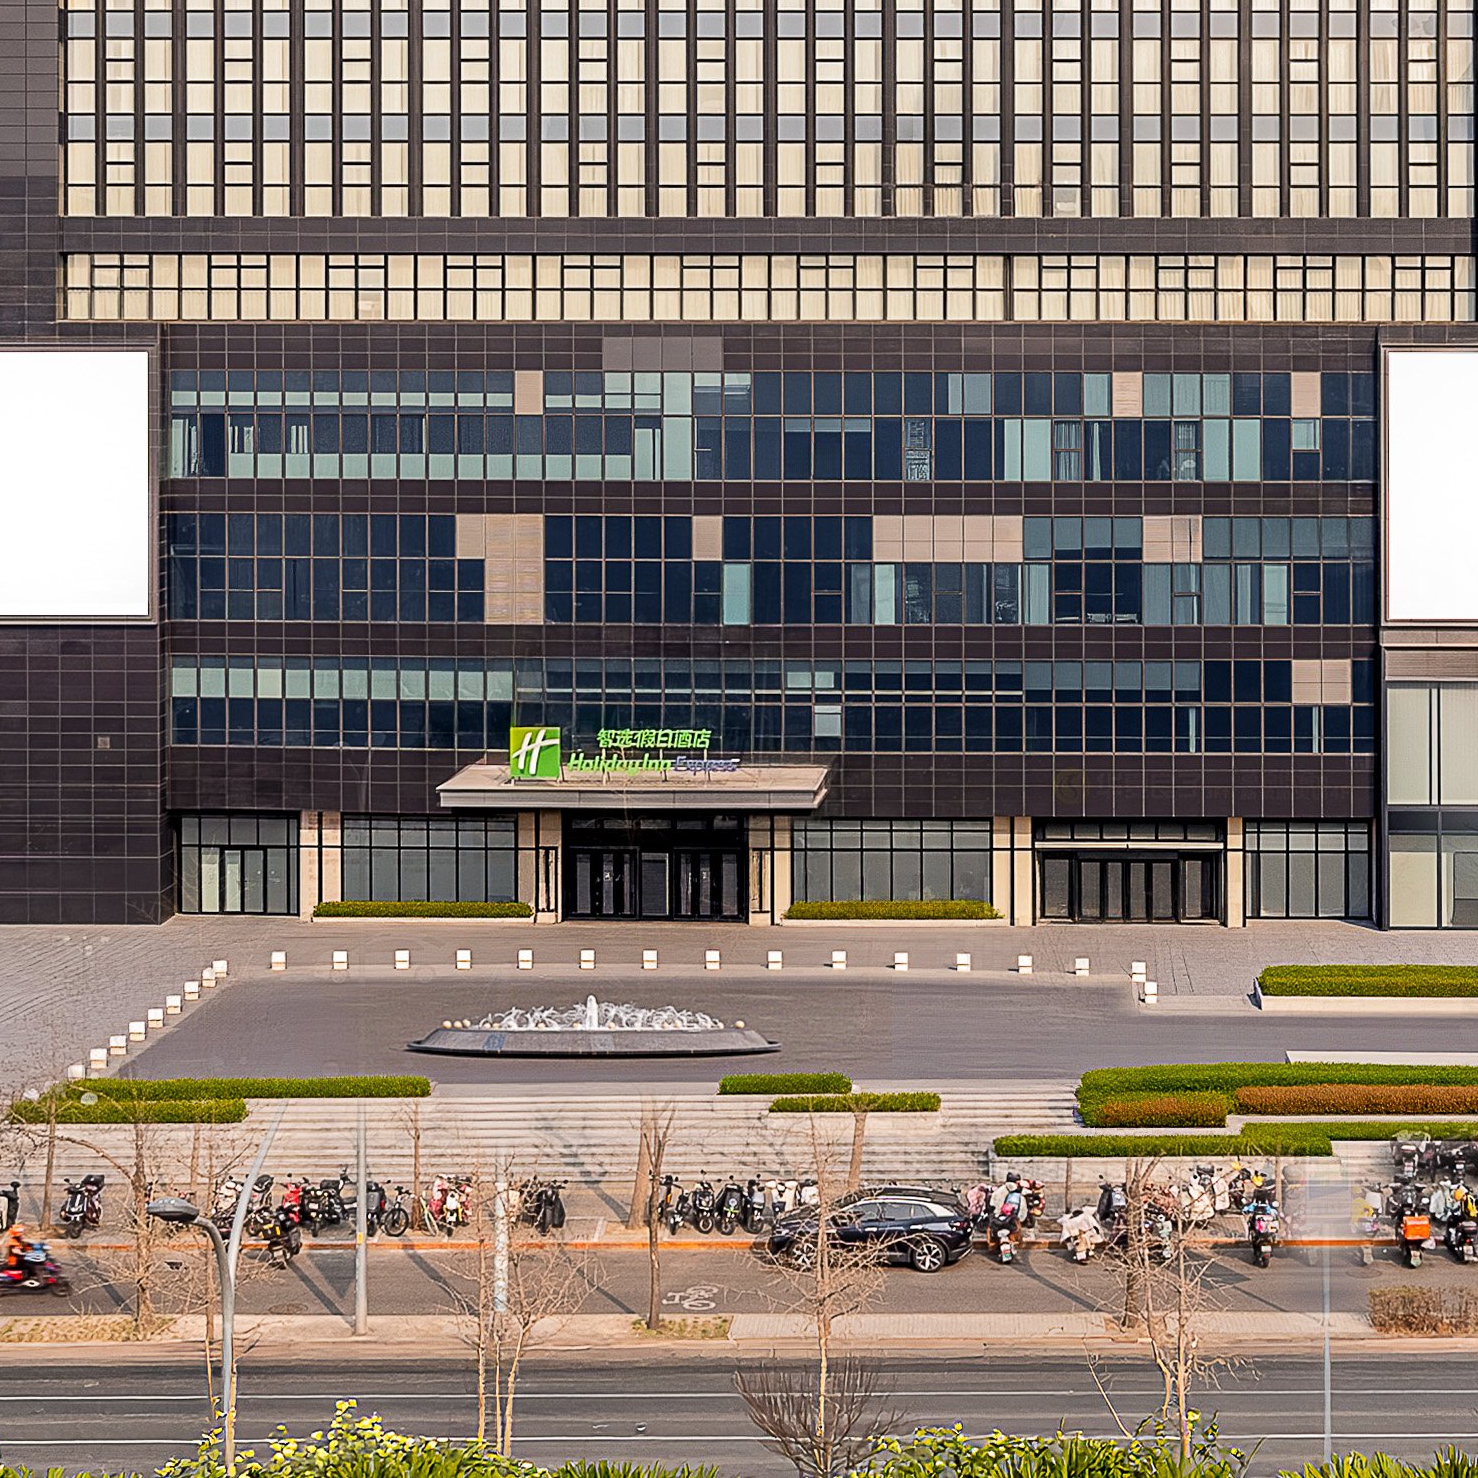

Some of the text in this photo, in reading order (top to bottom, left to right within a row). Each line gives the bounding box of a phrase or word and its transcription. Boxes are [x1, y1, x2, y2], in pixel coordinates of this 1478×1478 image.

[597, 728, 712, 748] 智选假日酒店
[567, 752, 640, 776] Holiday
[642, 753, 672, 772] Inn
